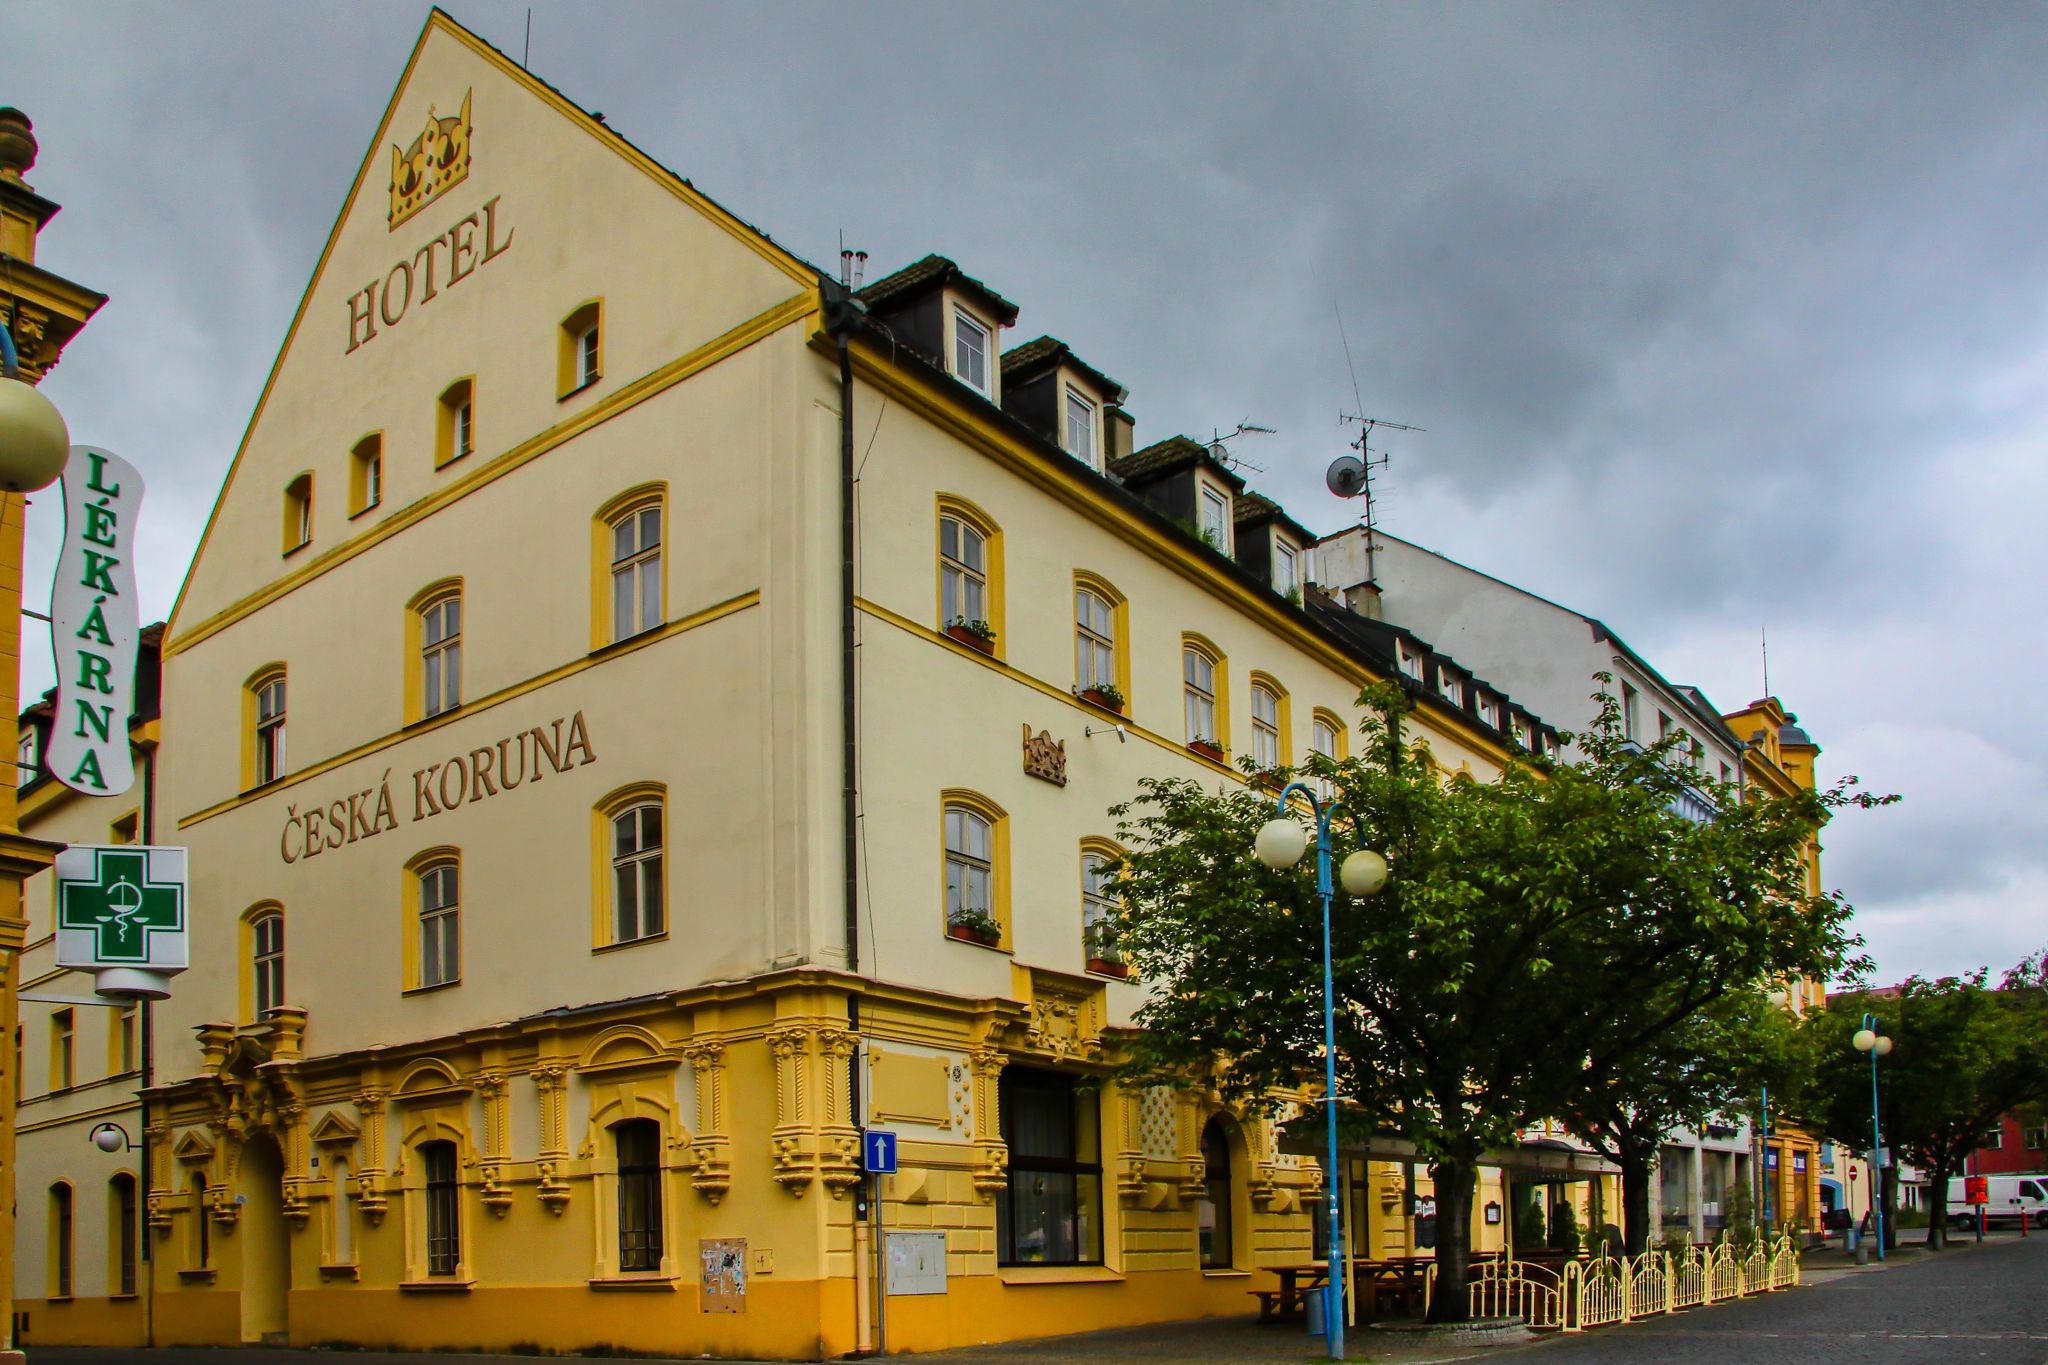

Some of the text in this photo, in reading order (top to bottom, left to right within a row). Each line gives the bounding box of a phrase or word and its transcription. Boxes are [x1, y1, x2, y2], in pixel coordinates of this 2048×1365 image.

[344, 194, 515, 355] HOTEL
[70, 452, 121, 790] LÉKÁRNA
[280, 709, 598, 865] ČESKÁ KORUNA
